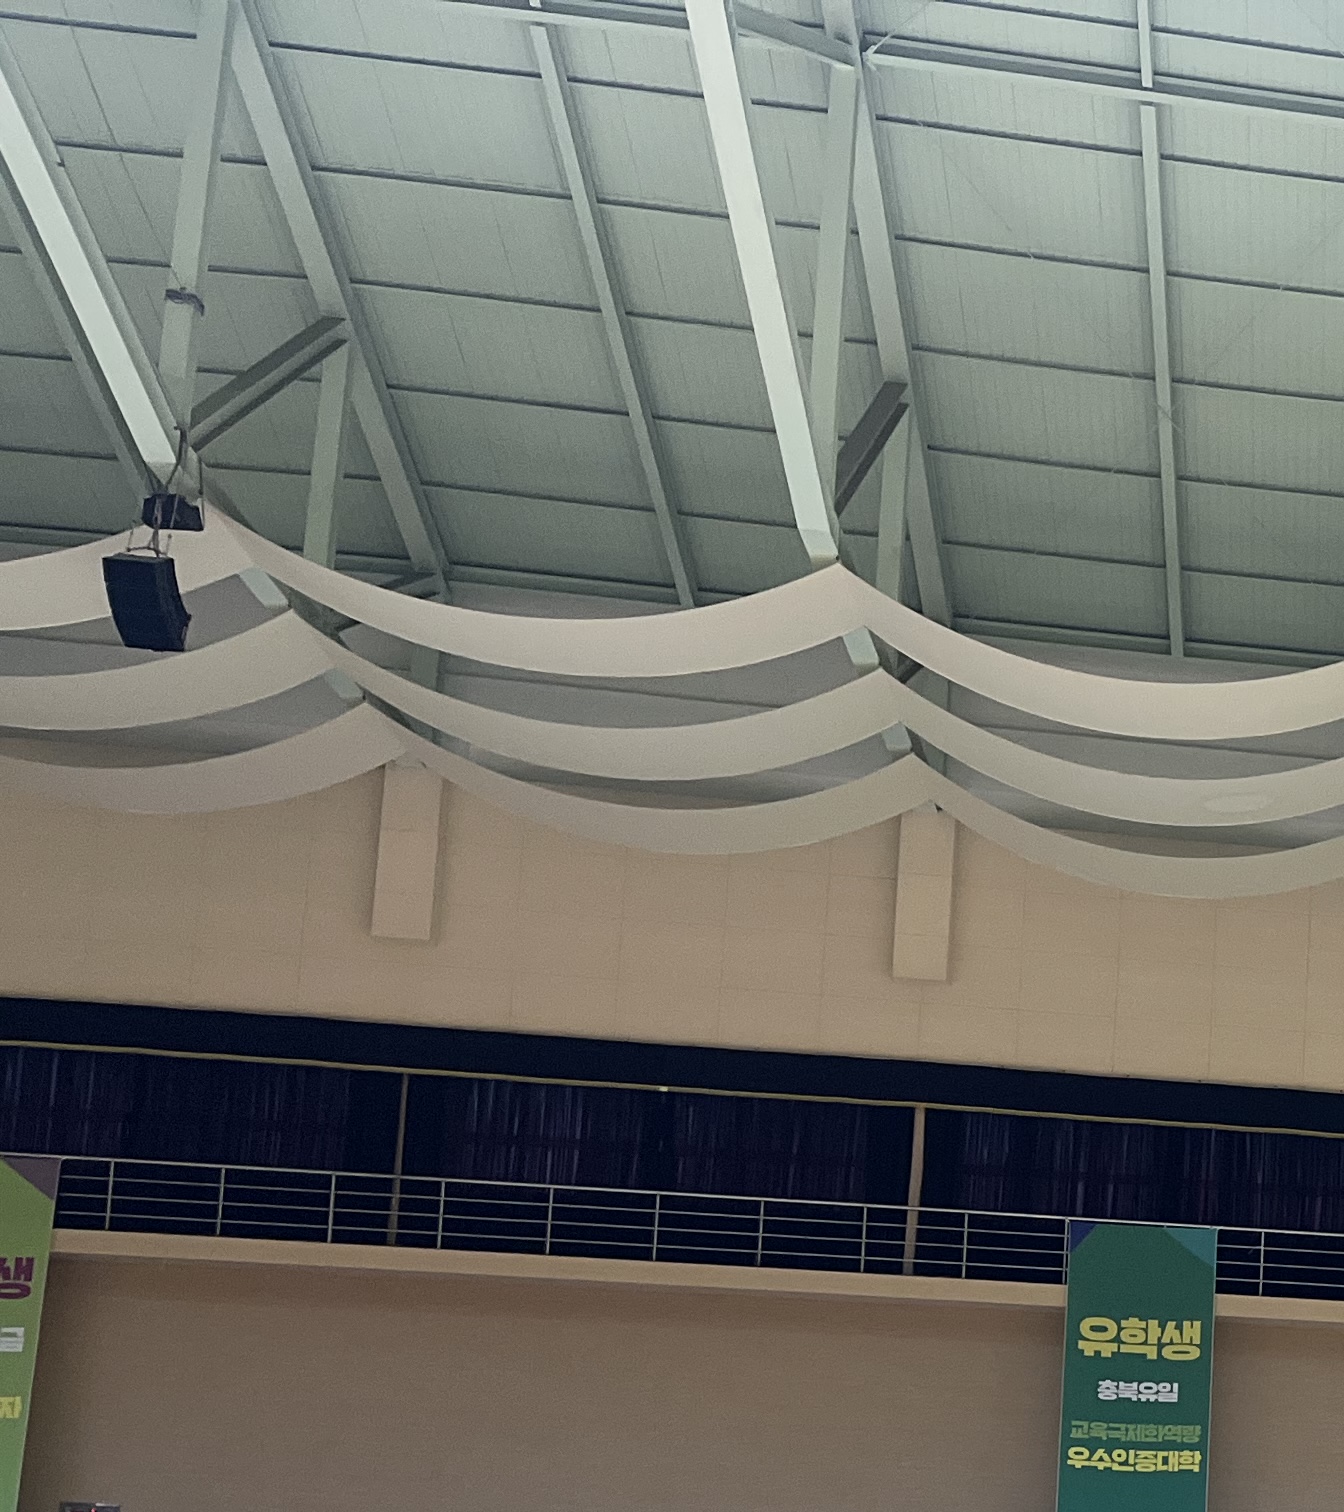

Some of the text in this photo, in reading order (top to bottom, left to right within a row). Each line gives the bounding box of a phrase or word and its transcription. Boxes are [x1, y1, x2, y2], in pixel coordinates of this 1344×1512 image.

[1077, 1316, 1201, 1361] 유학생
[1097, 1380, 1179, 1403] 충북유일
[1070, 1420, 1202, 1443] 교육국제화역량
[1067, 1446, 1202, 1472] 우수인증대학
